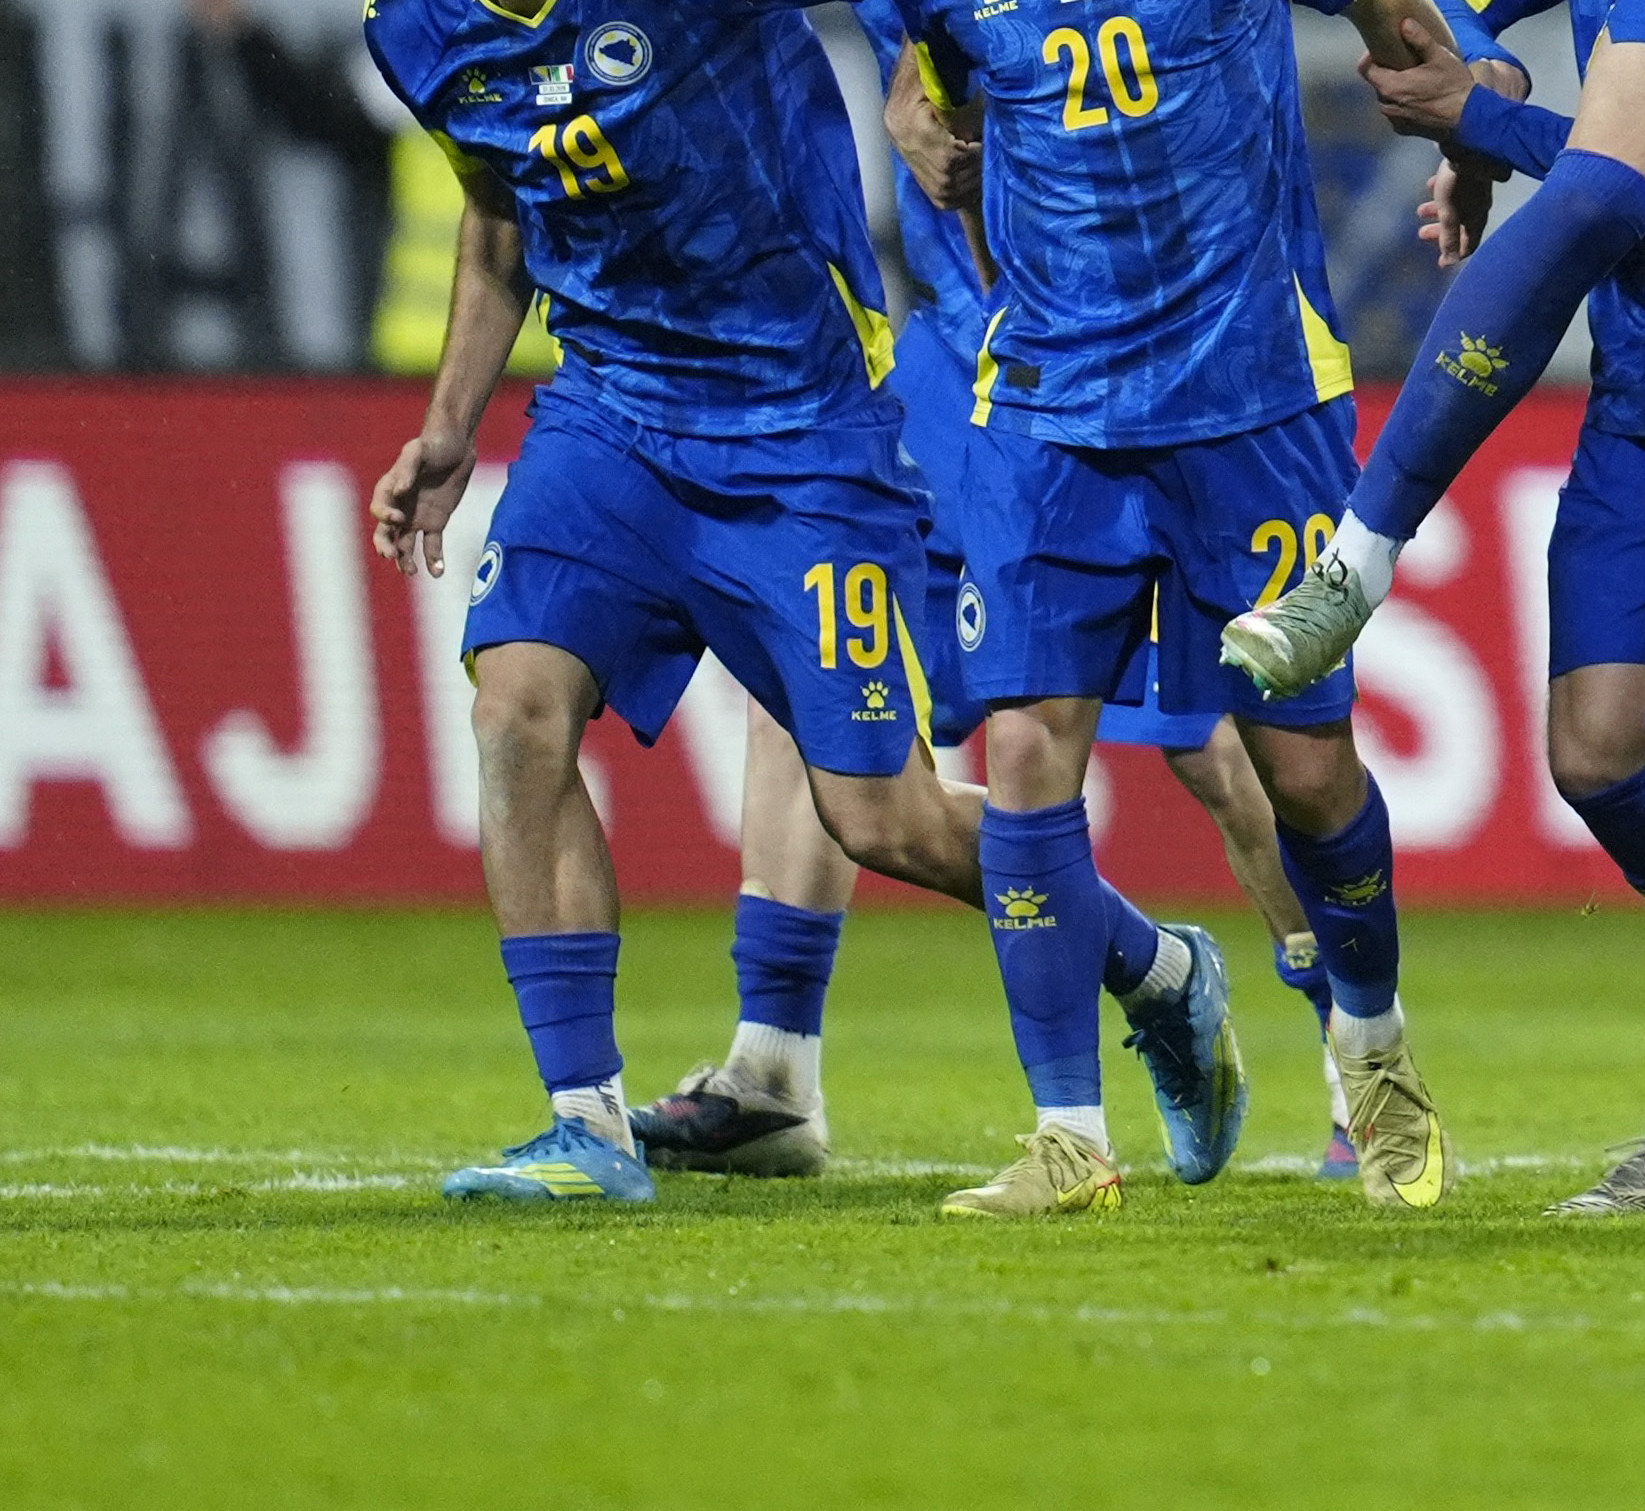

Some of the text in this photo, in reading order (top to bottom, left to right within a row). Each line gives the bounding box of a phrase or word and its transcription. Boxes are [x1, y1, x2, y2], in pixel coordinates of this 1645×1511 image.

[1042, 15, 1160, 131] 20
[528, 112, 632, 199] 19
[1434, 350, 1497, 398] KELME
[803, 562, 889, 670] 19
[850, 710, 898, 722] KELME
[992, 915, 1058, 931] KELME
